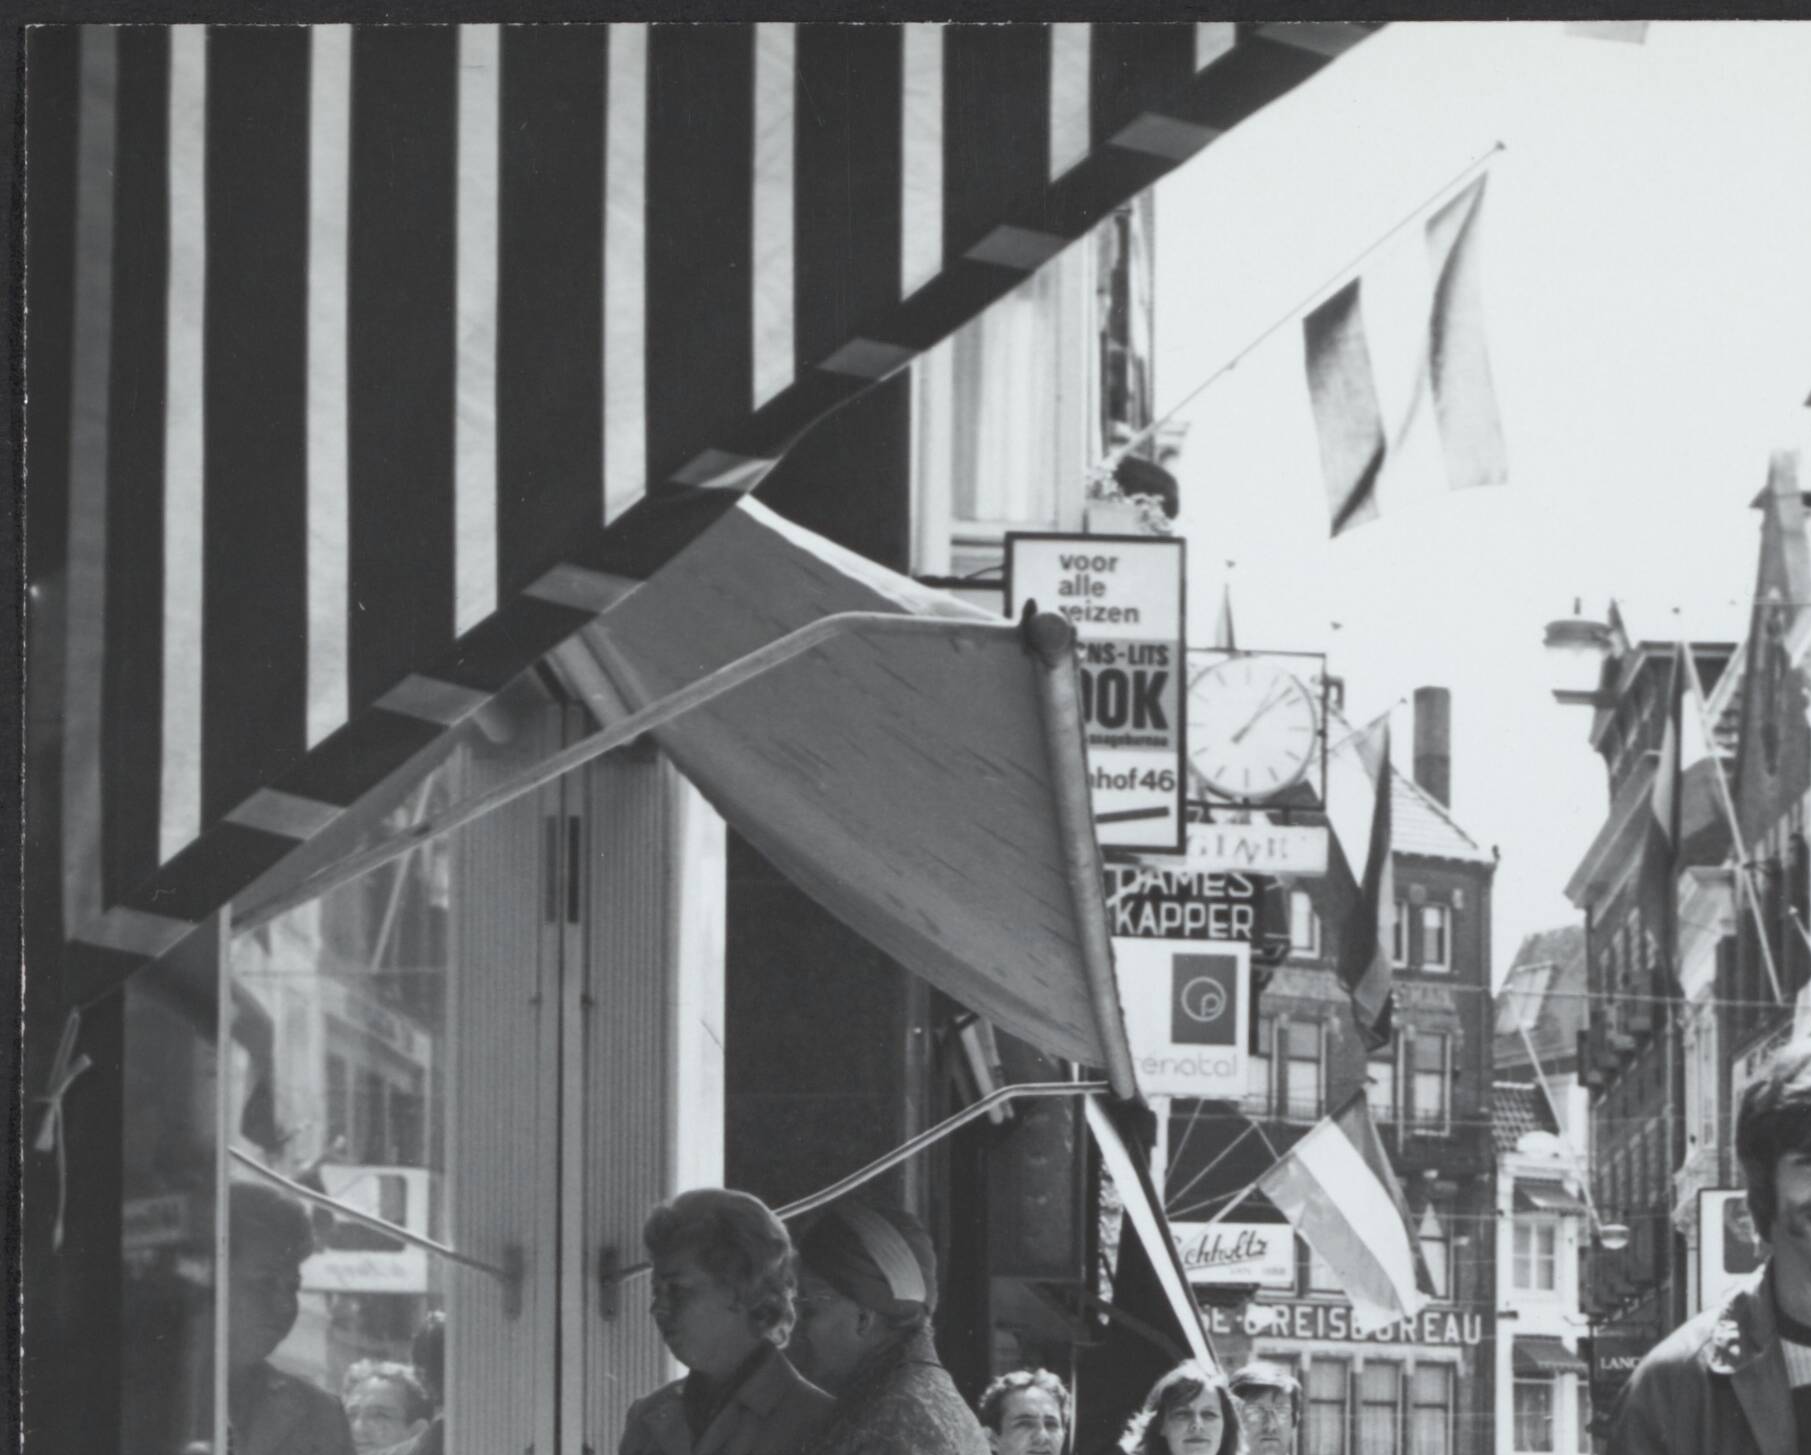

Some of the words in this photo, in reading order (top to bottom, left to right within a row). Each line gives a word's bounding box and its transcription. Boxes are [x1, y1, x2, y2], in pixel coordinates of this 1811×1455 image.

[1058, 554, 1118, 574] voor
[1058, 573, 1107, 598] alle
[1139, 768, 1175, 792] 46
[1115, 863, 1254, 898] DAMES
[1115, 901, 1254, 939] KAPPER
